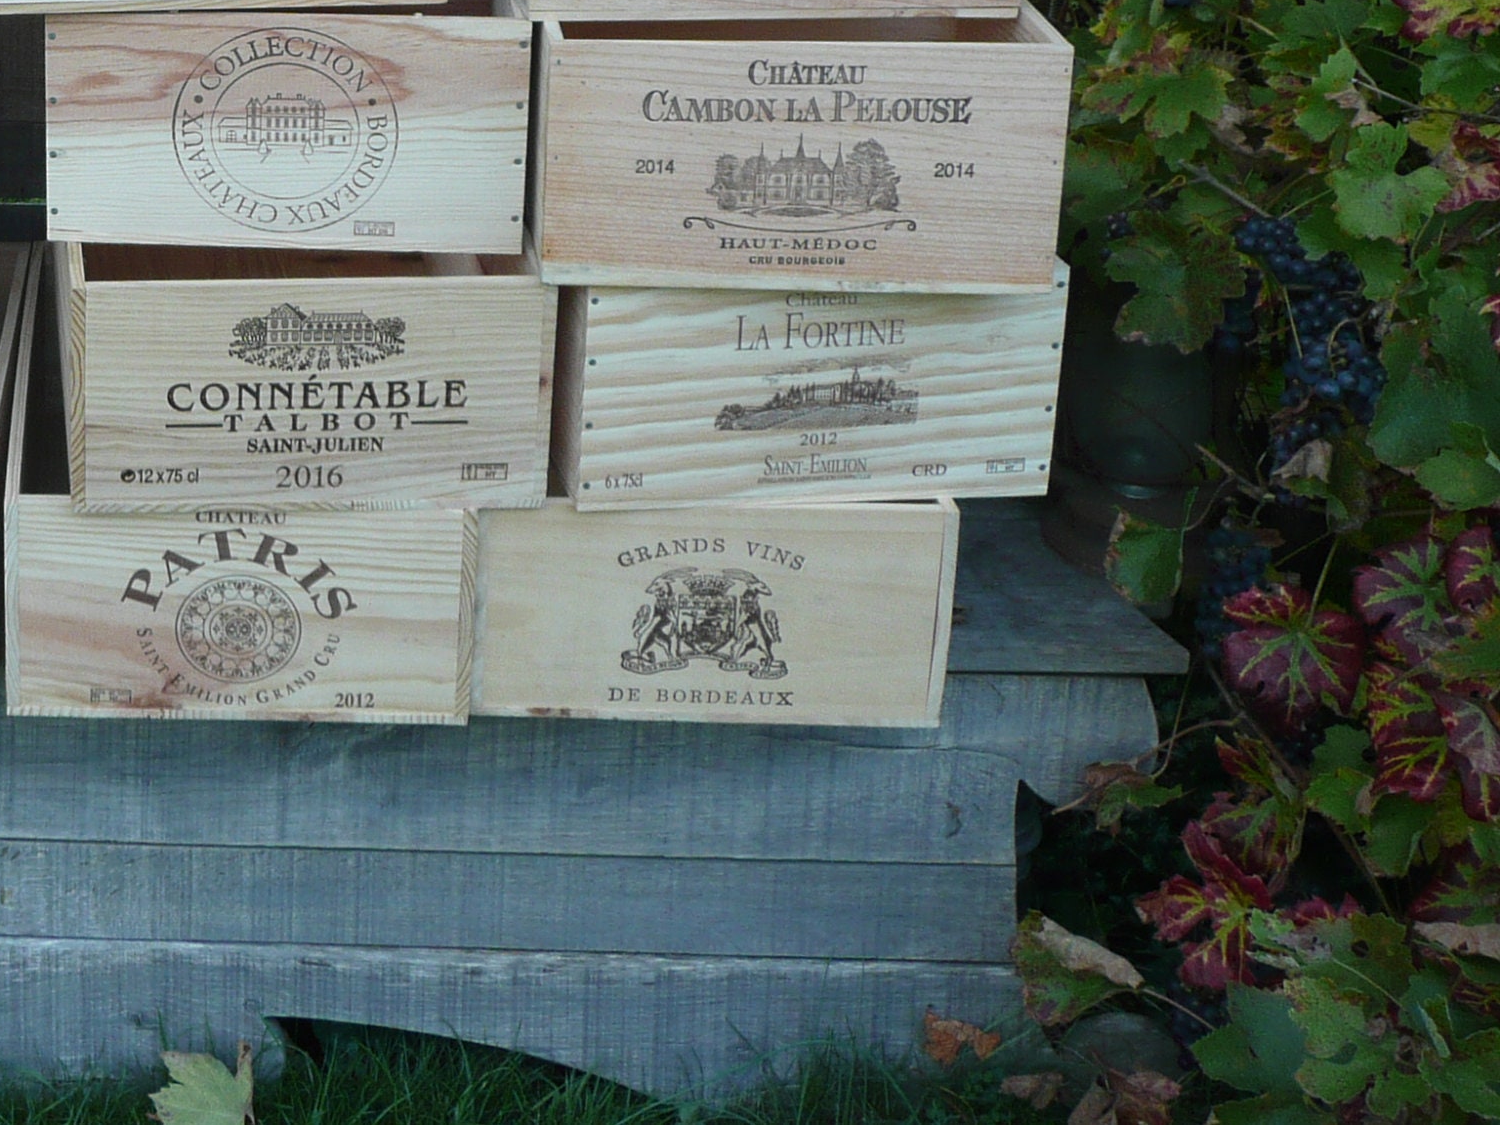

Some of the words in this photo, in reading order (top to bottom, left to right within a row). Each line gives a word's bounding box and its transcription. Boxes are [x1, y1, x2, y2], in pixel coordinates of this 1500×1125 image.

[200, 35, 373, 93] COLLECTION
[748, 59, 866, 85] CHÂTEAU
[642, 90, 776, 124] CAMBON
[783, 100, 822, 122] LA
[831, 90, 972, 125] PELOUSE
[181, 109, 278, 224] CHÂTEAUX
[286, 114, 389, 225] BORDEAUX
[635, 159, 675, 175] 2014
[934, 163, 975, 178] 2014
[720, 234, 878, 250] HAUT-MÉDOC
[749, 256, 772, 264] CRU
[778, 256, 845, 265] BOURGEOIS
[735, 315, 770, 351] LA
[783, 312, 905, 350] FORTINE
[166, 375, 468, 412] CONNÉTABLE
[223, 412, 410, 432] TALBOT
[246, 437, 385, 455] SAINT-JULIEN
[800, 432, 837, 446] 2012
[275, 464, 343, 489] 2016
[912, 464, 947, 477] CRD
[605, 475, 612, 489] 6
[617, 537, 727, 568] GRANDS
[746, 540, 808, 572] VINS
[121, 528, 358, 621] PATRIS
[136, 626, 171, 676] SAINT
[167, 673, 248, 706] EMILION
[255, 668, 317, 705] GRAND
[313, 632, 342, 668] CRU
[335, 692, 374, 709] 2012
[608, 687, 641, 702] DE
[656, 688, 795, 706] BORDEAUX
